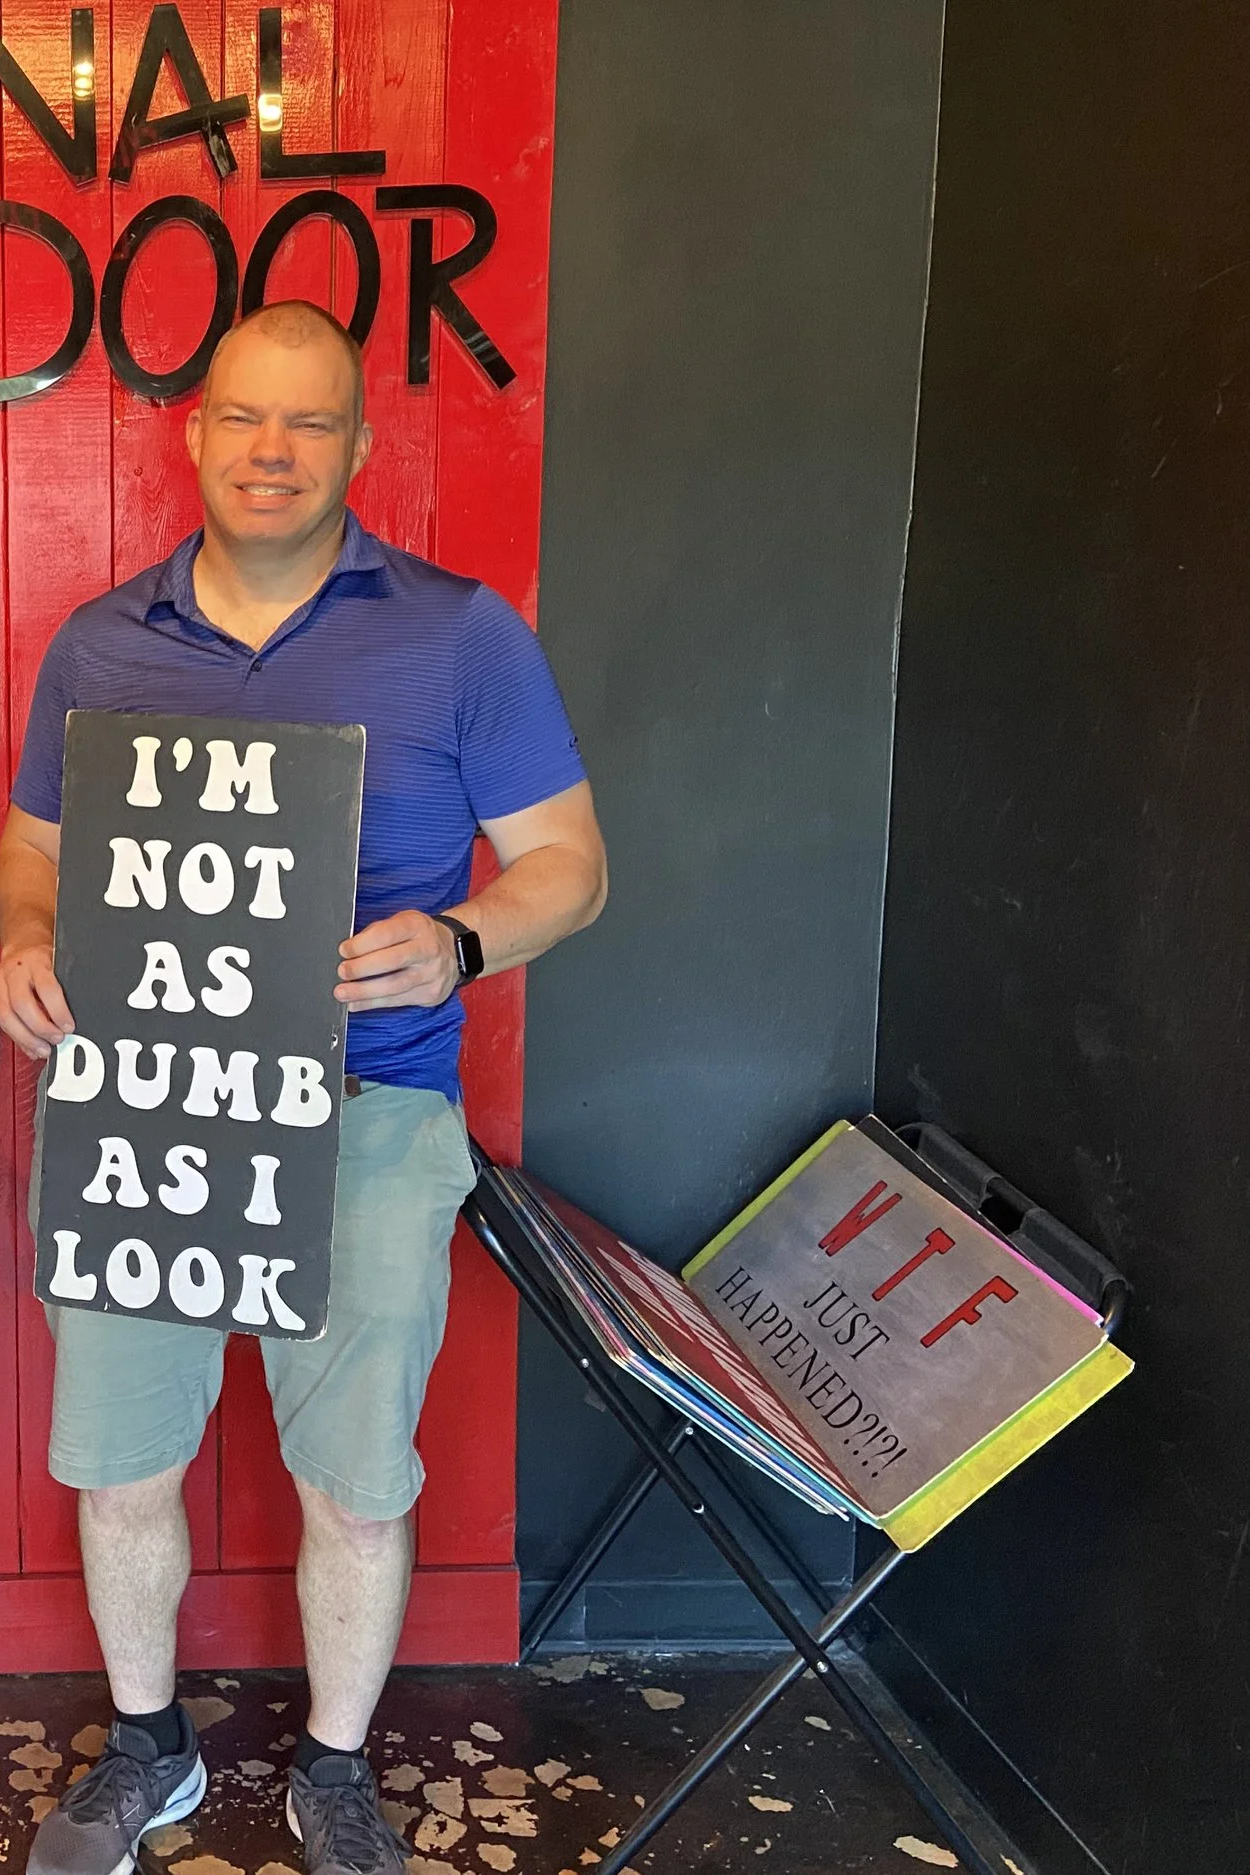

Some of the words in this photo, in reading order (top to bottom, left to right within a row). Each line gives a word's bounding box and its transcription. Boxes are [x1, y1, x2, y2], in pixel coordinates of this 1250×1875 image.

[126, 736, 279, 813] I'M
[104, 838, 294, 919] NOT
[127, 942, 253, 1017] AS
[47, 1034, 332, 1127] DUMB
[82, 1137, 209, 1215] AS
[243, 1155, 281, 1225] I
[50, 1230, 306, 1331] LOOK
[597, 1246, 680, 1326] DID
[803, 1281, 890, 1361] JUST
[617, 1239, 850, 1490] EVERYTHING
[714, 1266, 908, 1478] HAPPENED?!?!
